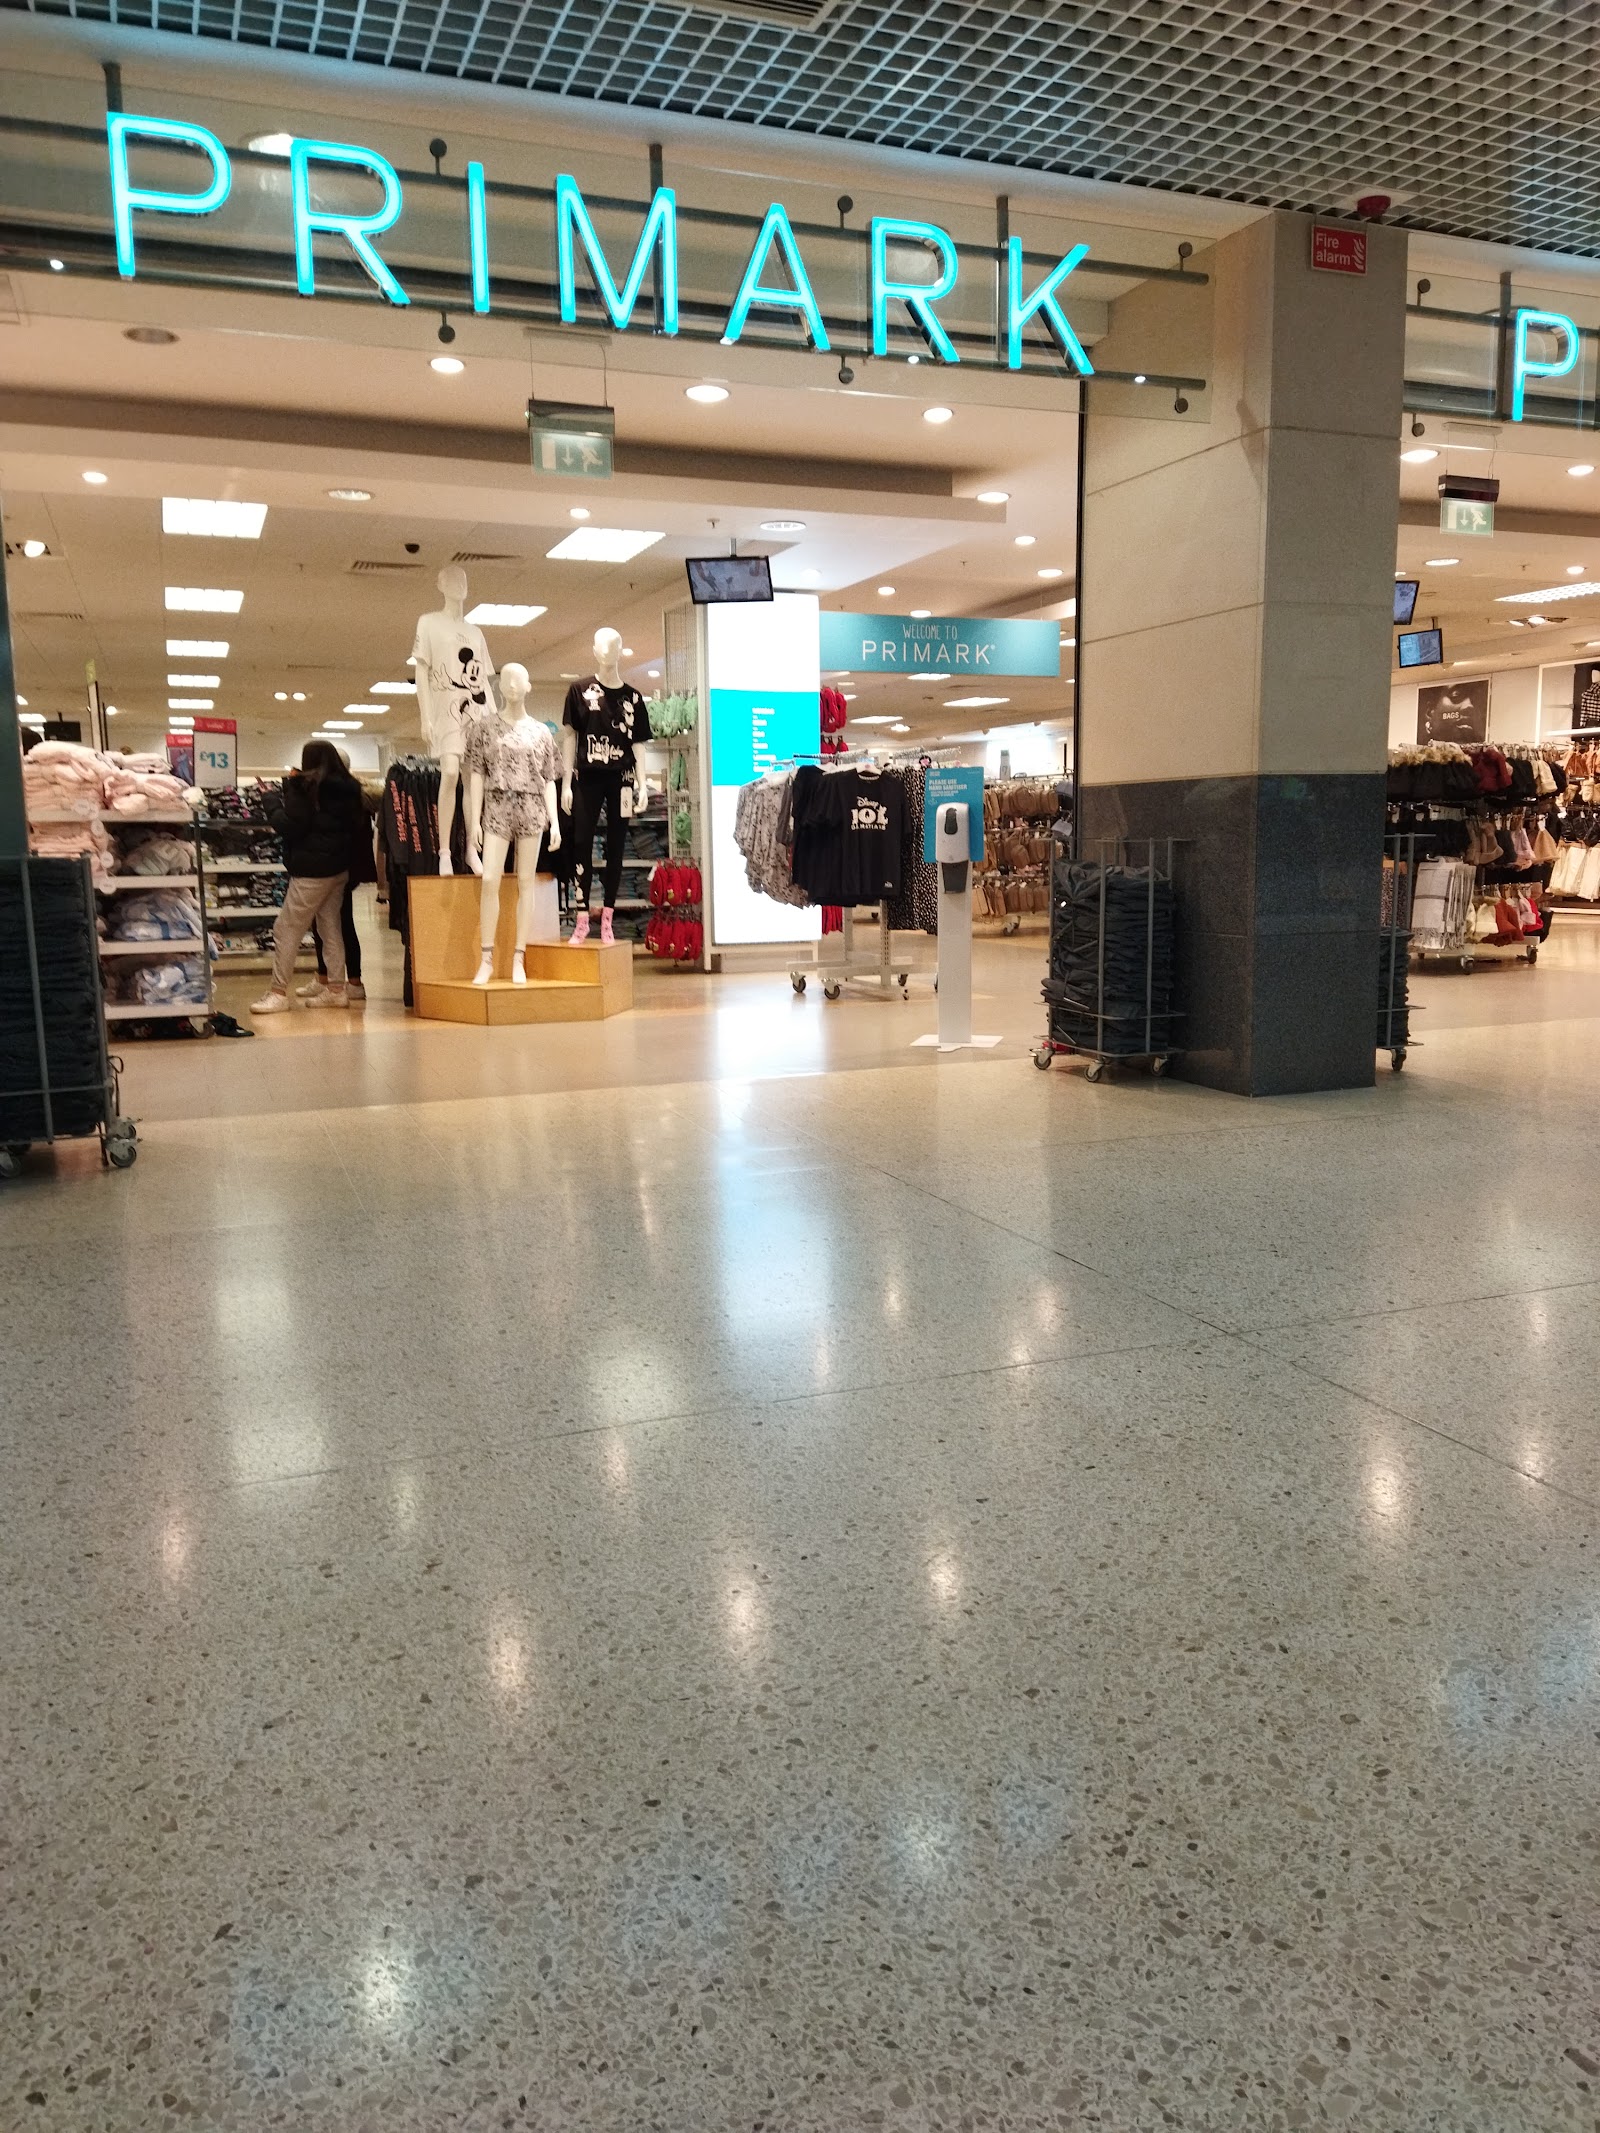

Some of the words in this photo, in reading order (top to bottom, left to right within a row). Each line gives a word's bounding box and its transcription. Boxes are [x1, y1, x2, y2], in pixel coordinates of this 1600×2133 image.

[106, 111, 1095, 377] PRIMARK
[1316, 233, 1340, 249] Fire
[1316, 249, 1351, 265] alarm
[1512, 308, 1579, 422] P
[902, 623, 941, 639] WELCOME
[945, 625, 958, 640] TO
[862, 640, 990, 665] PRIMARK
[1442, 711, 1460, 720] BAGS
[200, 751, 228, 768] £13
